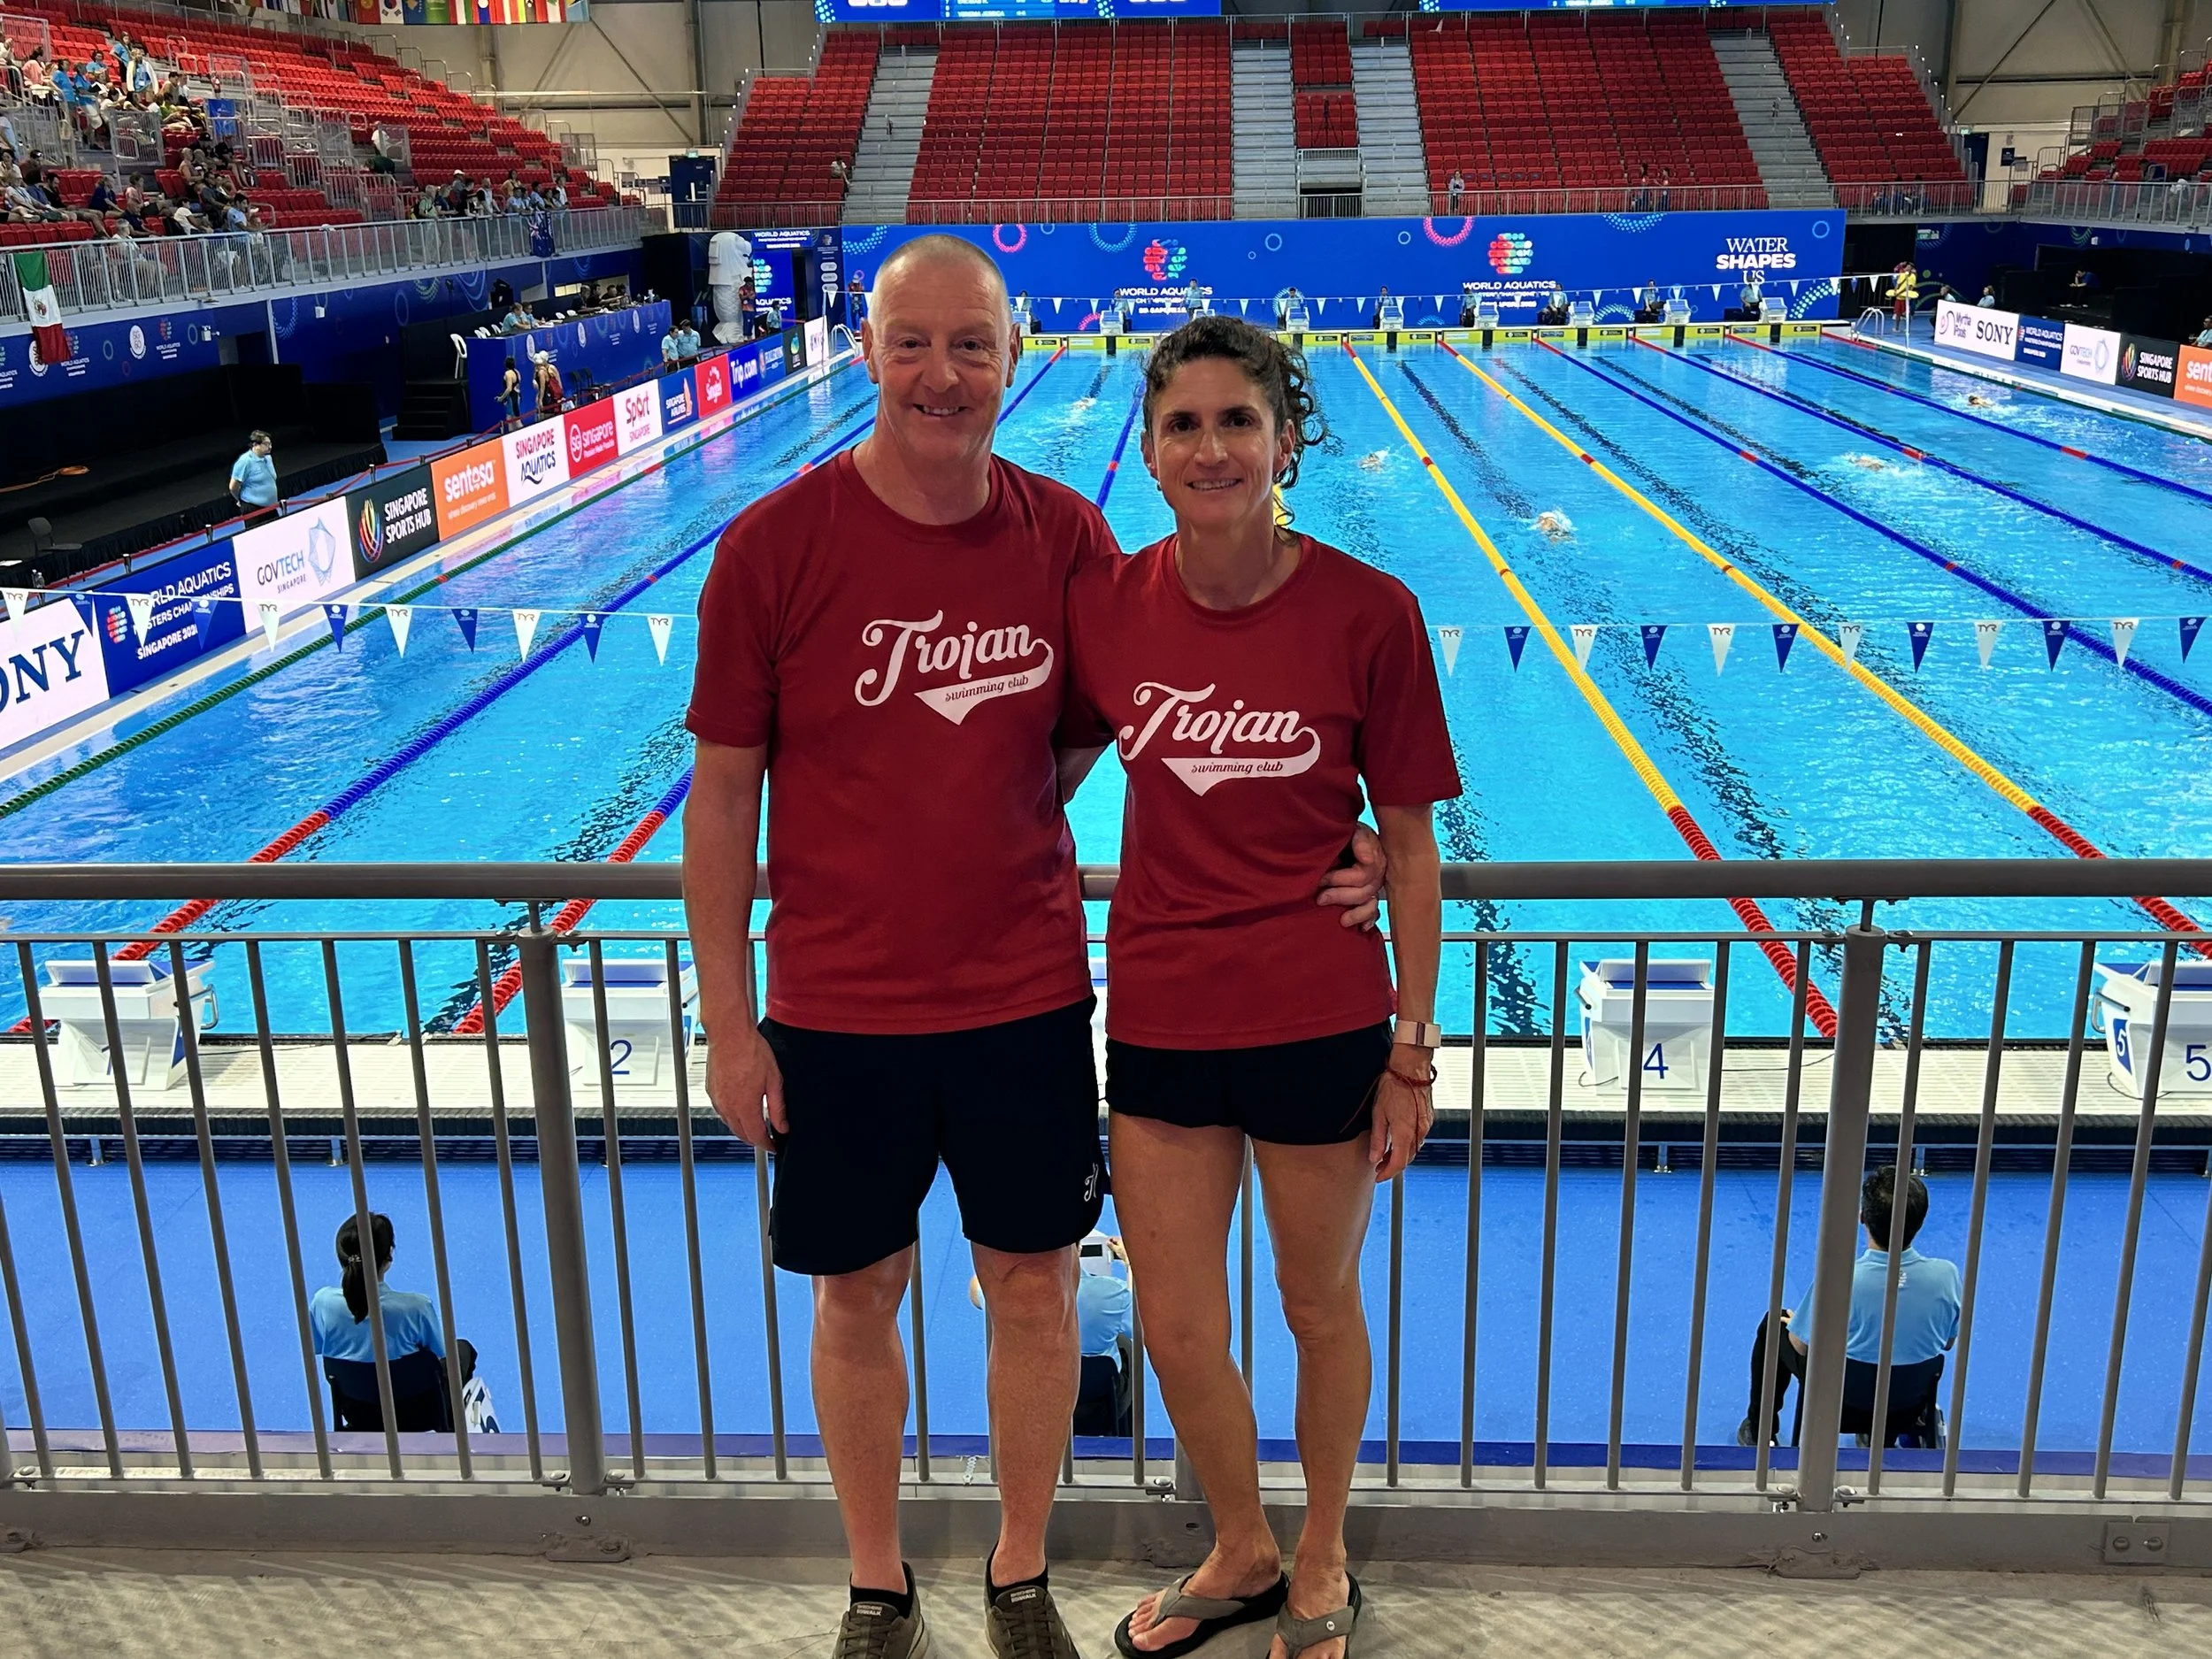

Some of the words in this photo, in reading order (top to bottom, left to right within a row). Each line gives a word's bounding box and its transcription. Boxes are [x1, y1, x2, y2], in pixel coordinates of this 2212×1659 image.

[1725, 237, 1788, 252] WATER
[1716, 253, 1796, 269] SHAPES
[1463, 281, 1502, 290] WORLD
[1503, 280, 1556, 289] AQUATICS
[1742, 270, 1766, 284] US
[1119, 288, 1159, 296] WORLD
[1955, 311, 1972, 326] Myrtha
[1976, 320, 2014, 345] SONY
[2041, 329, 2063, 342] AQUATICS
[2139, 351, 2173, 369] SINGAPORE
[730, 358, 757, 388] Trip.com
[2137, 365, 2159, 381] SPORTS
[2159, 371, 2172, 384] HUB
[626, 390, 650, 427] Sport
[629, 424, 650, 442] SINGAPORE
[516, 428, 555, 459] SINGAPORE
[520, 451, 556, 484] AQUATICS
[444, 460, 495, 503] sentosa
[384, 488, 428, 522] SINGAPORE
[385, 516, 415, 544] SPORTS
[414, 509, 432, 534] HUB
[257, 549, 305, 587] GOVTECH
[177, 561, 232, 596] AQUATICS
[277, 574, 307, 594] SINGAPORE
[6, 592, 24, 603] TYR
[131, 598, 150, 607] TYR
[259, 603, 278, 612] TYR
[389, 608, 409, 618] TYR
[517, 613, 534, 622] TYR
[650, 617, 669, 626] TYR
[2113, 621, 2134, 631] TYR
[1441, 628, 1460, 638] TYR
[1573, 628, 1593, 637] TYR
[1712, 626, 1731, 636] TYR
[1842, 625, 1861, 634] TYR
[1978, 623, 1997, 633] TYR
[137, 631, 182, 660] SINGAPORE
[854, 609, 1048, 707] Trojan
[944, 680, 1005, 703] swimming
[1007, 675, 1030, 693] club
[1118, 681, 1310, 761] Trojan
[1190, 761, 1253, 774] swimming
[1256, 760, 1284, 772] club
[2116, 1028, 2127, 1056] 5
[610, 1039, 633, 1075] 2
[1643, 1043, 1669, 1079] 4
[2185, 1044, 2211, 1081] 5
